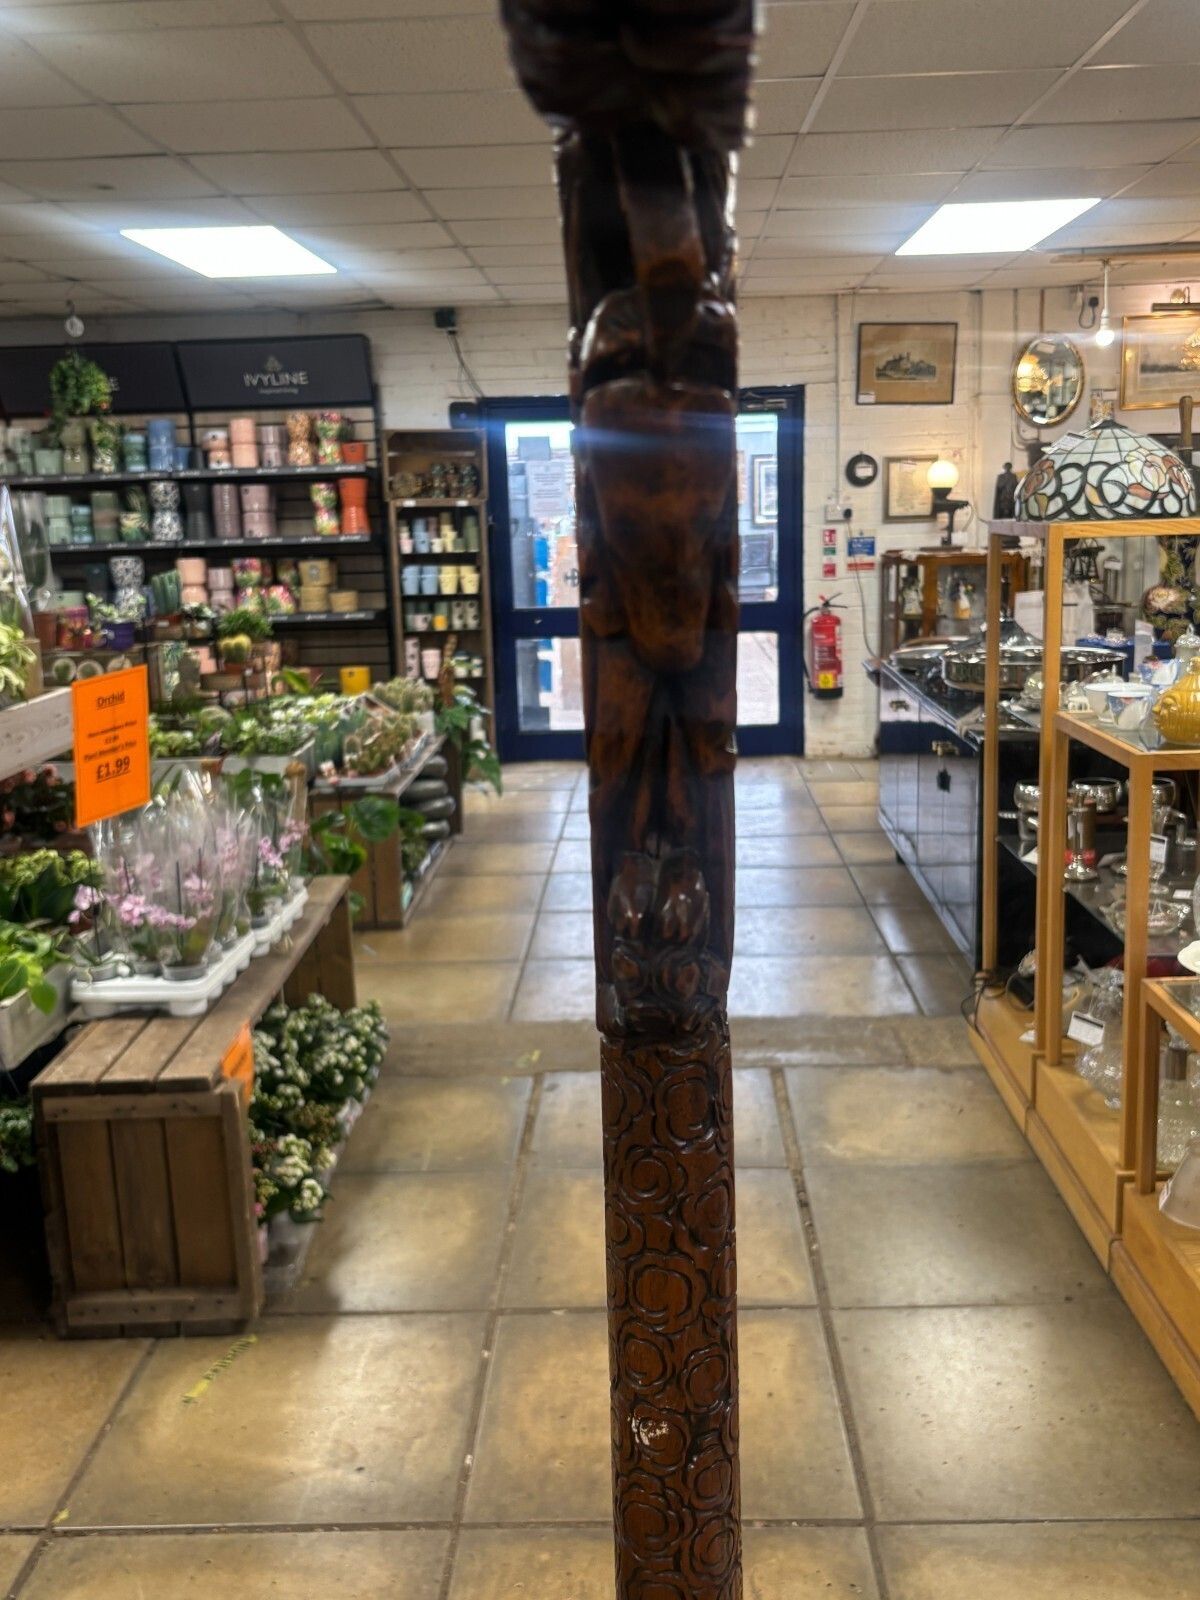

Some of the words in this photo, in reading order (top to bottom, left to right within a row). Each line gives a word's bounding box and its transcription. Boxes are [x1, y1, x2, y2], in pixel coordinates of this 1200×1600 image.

[243, 371, 309, 387] IVYLINE
[96, 691, 126, 708] Orchid
[96, 756, 130, 780] £1.99
